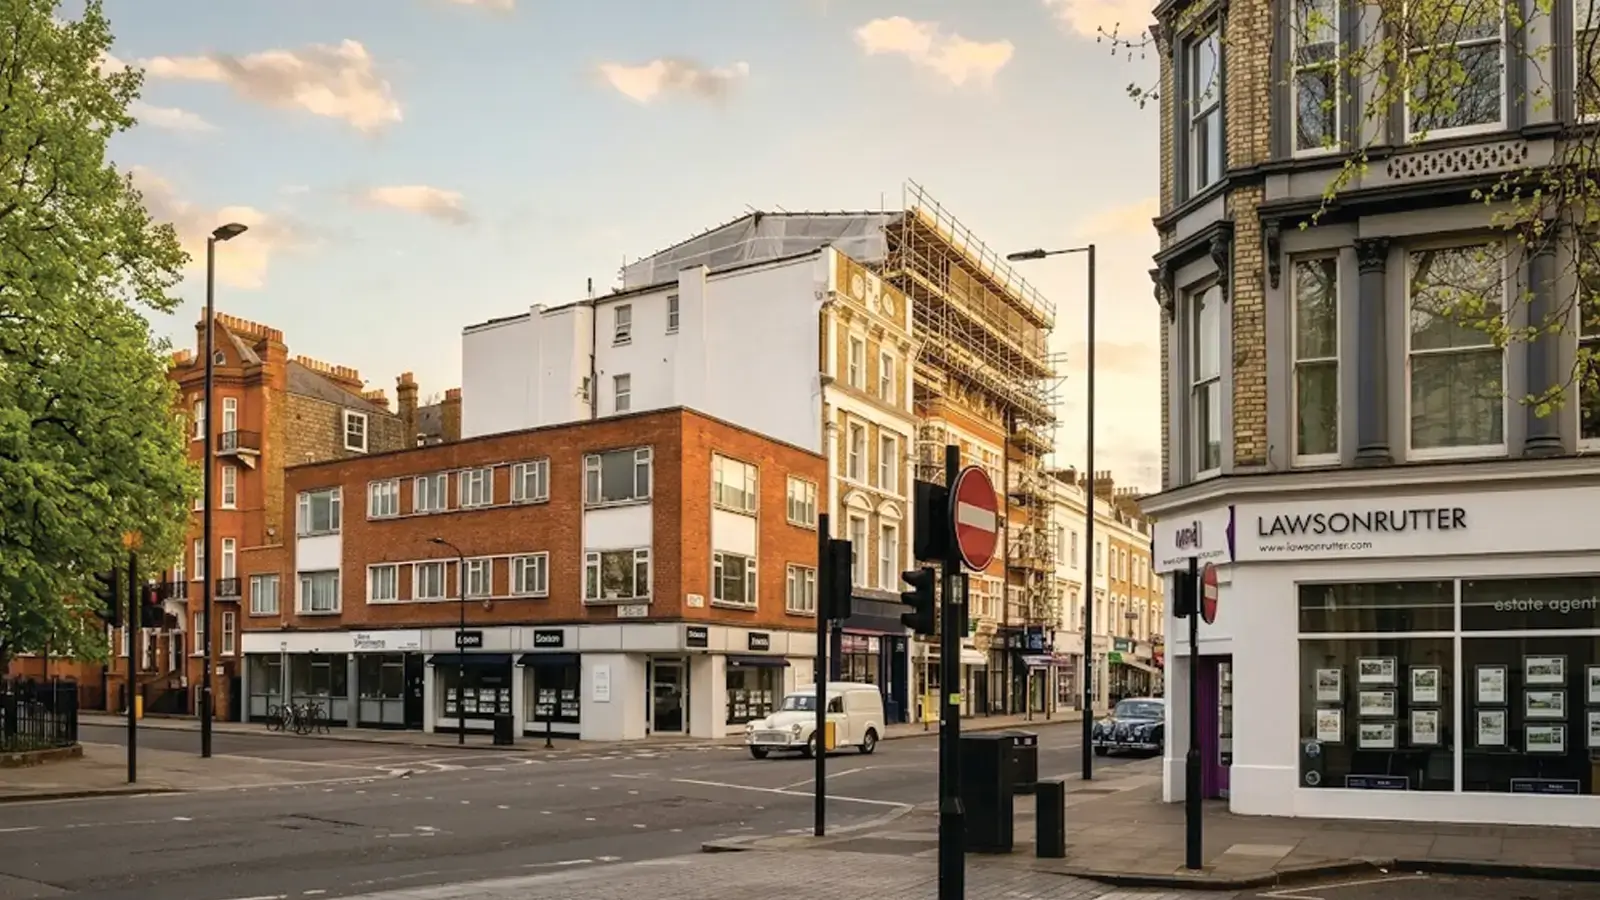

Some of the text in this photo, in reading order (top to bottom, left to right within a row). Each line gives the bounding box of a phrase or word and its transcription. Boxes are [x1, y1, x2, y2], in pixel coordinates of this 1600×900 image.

[1257, 507, 1467, 537] LAWSONRUTTER
[1259, 540, 1373, 552] www.lawsonrutter.com
[1494, 596, 1597, 614] estate agent
